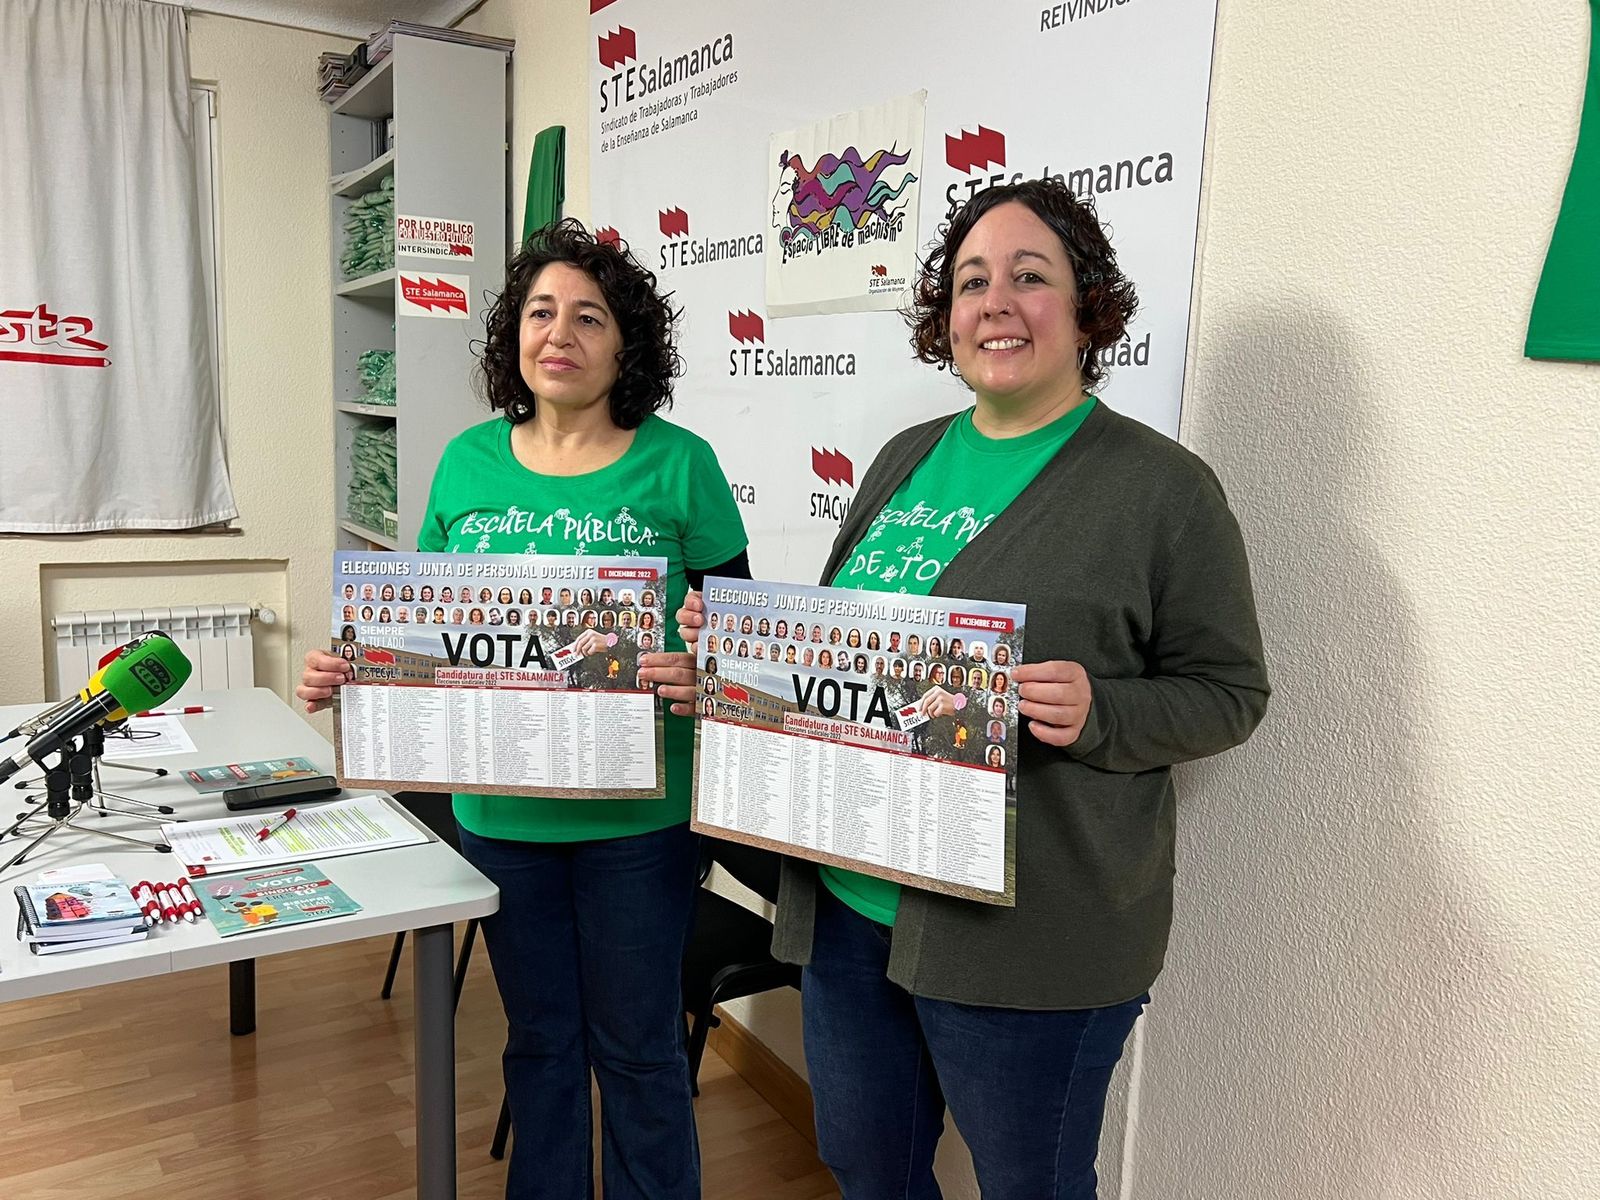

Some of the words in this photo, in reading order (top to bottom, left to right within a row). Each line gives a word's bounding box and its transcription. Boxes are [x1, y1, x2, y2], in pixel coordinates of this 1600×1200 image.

[638, 33, 733, 97] Salamanca
[601, 115, 628, 134] Sindicato
[629, 110, 638, 122] de
[639, 94, 682, 119] Trabajadoras
[690, 71, 738, 99] Trabajadores
[601, 140, 609, 153] de
[610, 138, 616, 150] la
[617, 127, 649, 147] Enseñanza
[651, 122, 659, 135] de
[661, 109, 698, 132] Salamanca
[398, 218, 417, 229] POR
[419, 220, 431, 231] LO
[434, 220, 473, 235] PÚBLICO
[398, 228, 414, 240] POR
[415, 229, 447, 242] NUESTRO
[448, 232, 474, 244] FUTURO
[782, 239, 813, 264] Espacio
[816, 222, 841, 255] LIBRE
[842, 229, 854, 248] de
[858, 216, 903, 246] machismo
[690, 233, 763, 265] Salamanca
[869, 278, 880, 288] STE
[881, 277, 906, 287] Salamanca
[405, 287, 420, 296] STE
[422, 288, 464, 299] Salamanca
[766, 348, 856, 376] Salamanca
[461, 511, 554, 537] ESCUELA
[563, 512, 660, 546] PÚBLICA:
[341, 560, 411, 576] ELECCIONES
[416, 561, 454, 577] JUNTA
[457, 562, 473, 578] DE
[476, 563, 538, 579] PERSONAL
[540, 565, 595, 581] DOCENTE
[850, 550, 885, 576] DE
[608, 570, 637, 578] DICIEMBRE
[709, 587, 769, 608] ELECCIONES
[773, 593, 807, 612] JUNTA
[810, 597, 826, 614] DE
[827, 599, 887, 622] PERSONAL
[890, 606, 946, 627] DOCENTE
[360, 625, 405, 636] SIEMPRE
[959, 617, 992, 628] DICIEMBRE
[991, 620, 1007, 630] 2022
[360, 637, 366, 648] A
[367, 637, 379, 648] TU
[380, 637, 405, 649] LADO
[441, 632, 550, 671] VOTA
[721, 658, 760, 673] SIEMPRE
[436, 669, 484, 681] Candidatura
[485, 670, 498, 681] del
[500, 671, 514, 682] STE
[516, 672, 565, 684] SALAMANCA
[727, 671, 737, 684] TU
[738, 672, 759, 687] LADO
[791, 673, 893, 729] VOTA
[784, 725, 807, 735] Elecciones
[807, 728, 830, 739] sindicales
[829, 732, 842, 741] 2022
[785, 714, 829, 732] Candidatura
[830, 722, 843, 735] del
[844, 724, 858, 737] STE
[860, 727, 909, 747] SALAMANCA
[256, 875, 308, 888] VOTA
[256, 882, 319, 898] SINDICATO
[283, 895, 331, 907] SIEMPRE
[311, 898, 336, 907] LADO
